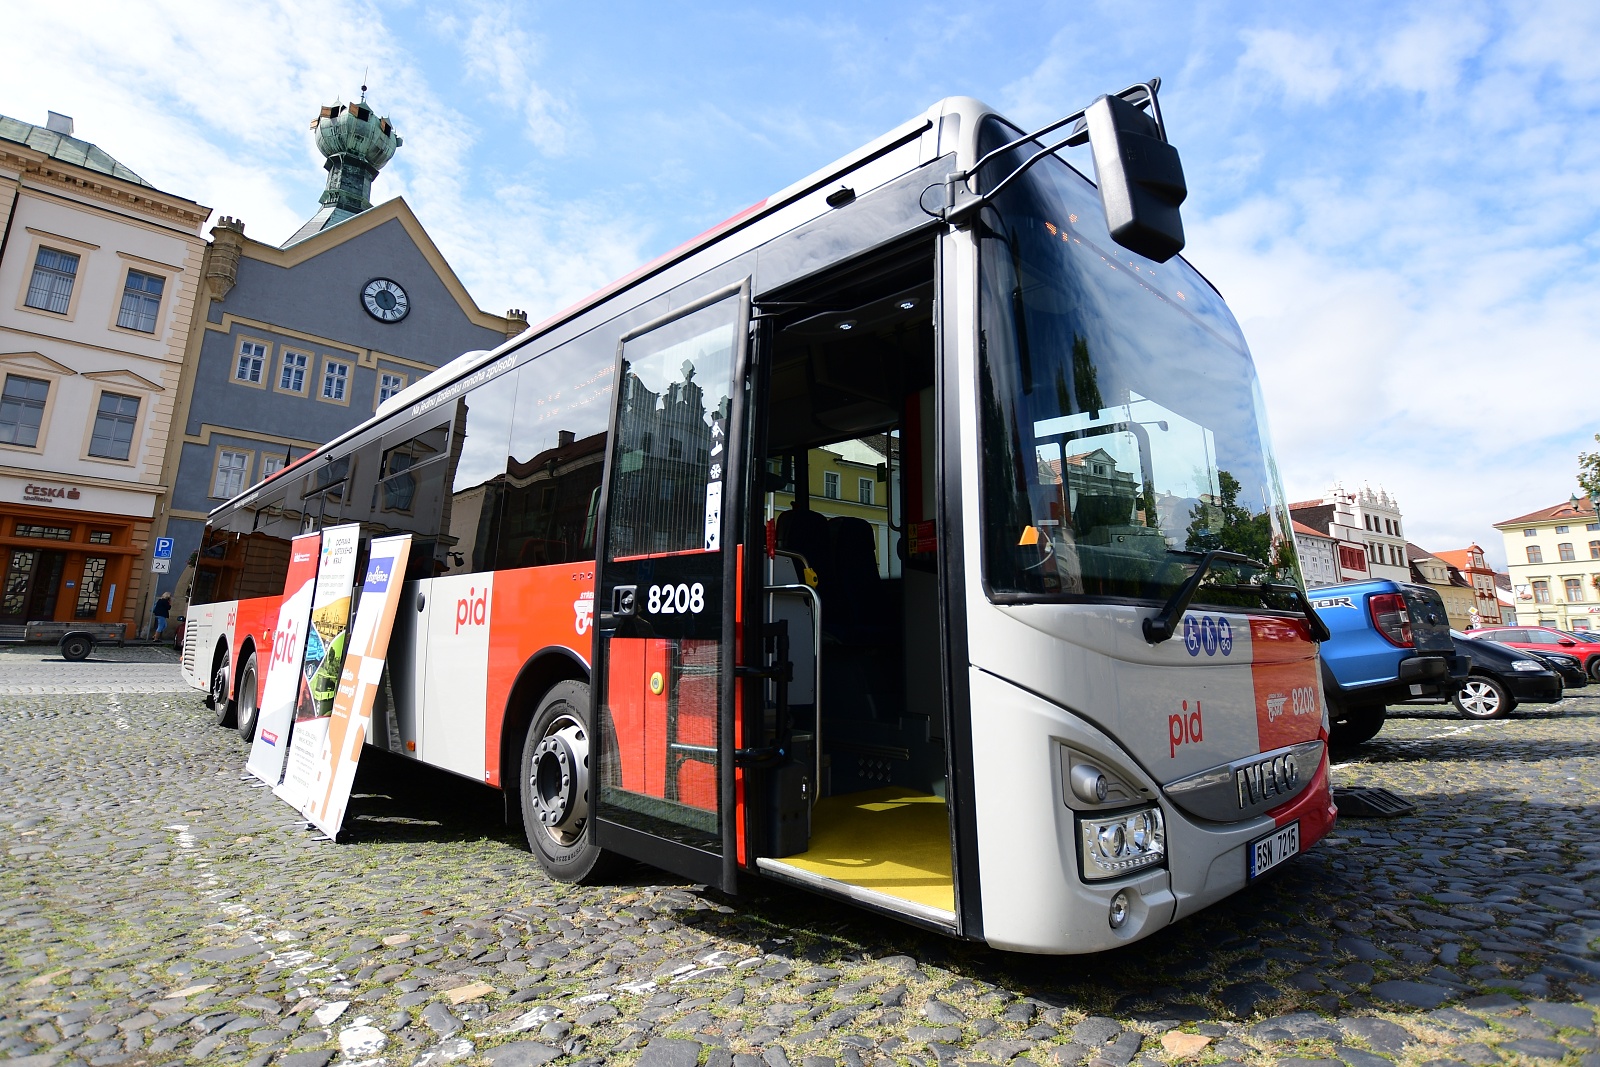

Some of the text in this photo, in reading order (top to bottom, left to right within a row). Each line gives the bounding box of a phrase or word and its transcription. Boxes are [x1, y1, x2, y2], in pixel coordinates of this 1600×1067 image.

[24, 483, 65, 498] ČESKÁ
[158, 540, 170, 552] P
[455, 587, 488, 635] pid
[647, 582, 705, 614] 8208
[271, 618, 299, 671] pid
[1292, 686, 1315, 716] 8208
[1168, 700, 1204, 758] pid
[1236, 754, 1299, 809] IVECO
[1257, 827, 1296, 871] 5SN 7215
